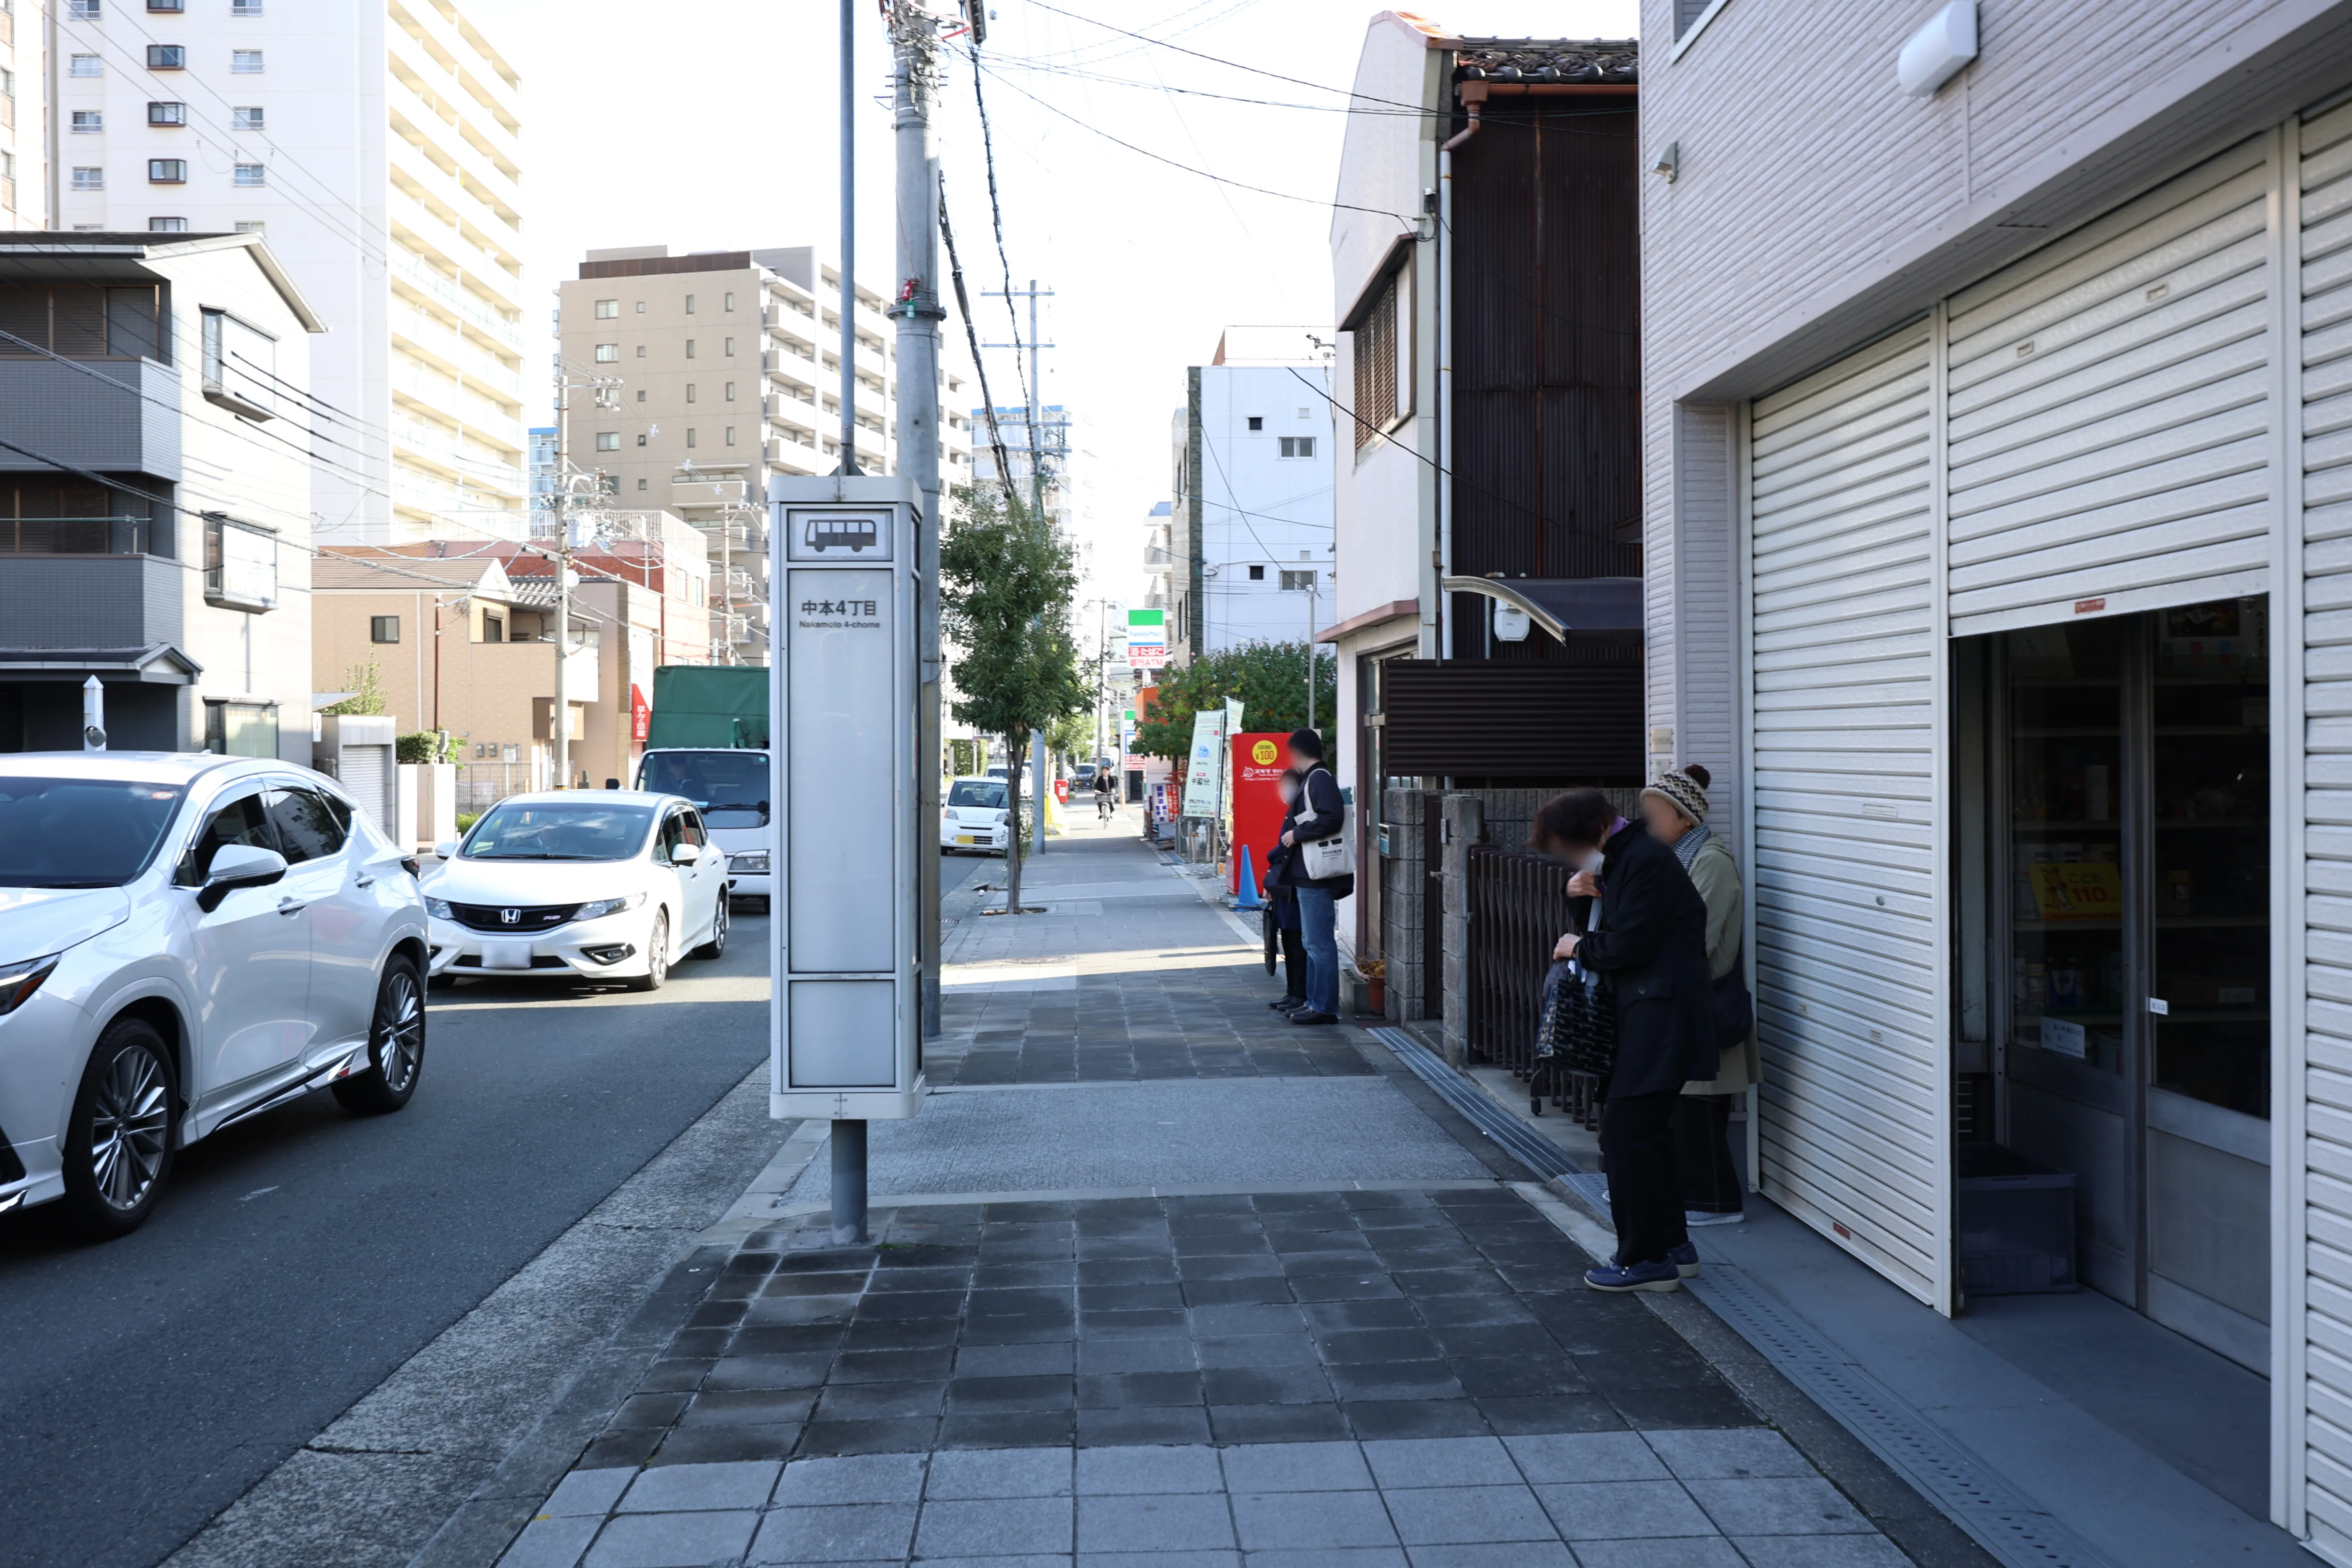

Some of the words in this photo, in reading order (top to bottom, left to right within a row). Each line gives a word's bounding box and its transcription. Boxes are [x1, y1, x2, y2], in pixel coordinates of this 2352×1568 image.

[802, 600, 875, 616] 中本4丁目
[2068, 872, 2102, 883] こども
[2071, 887, 2107, 903] 110
